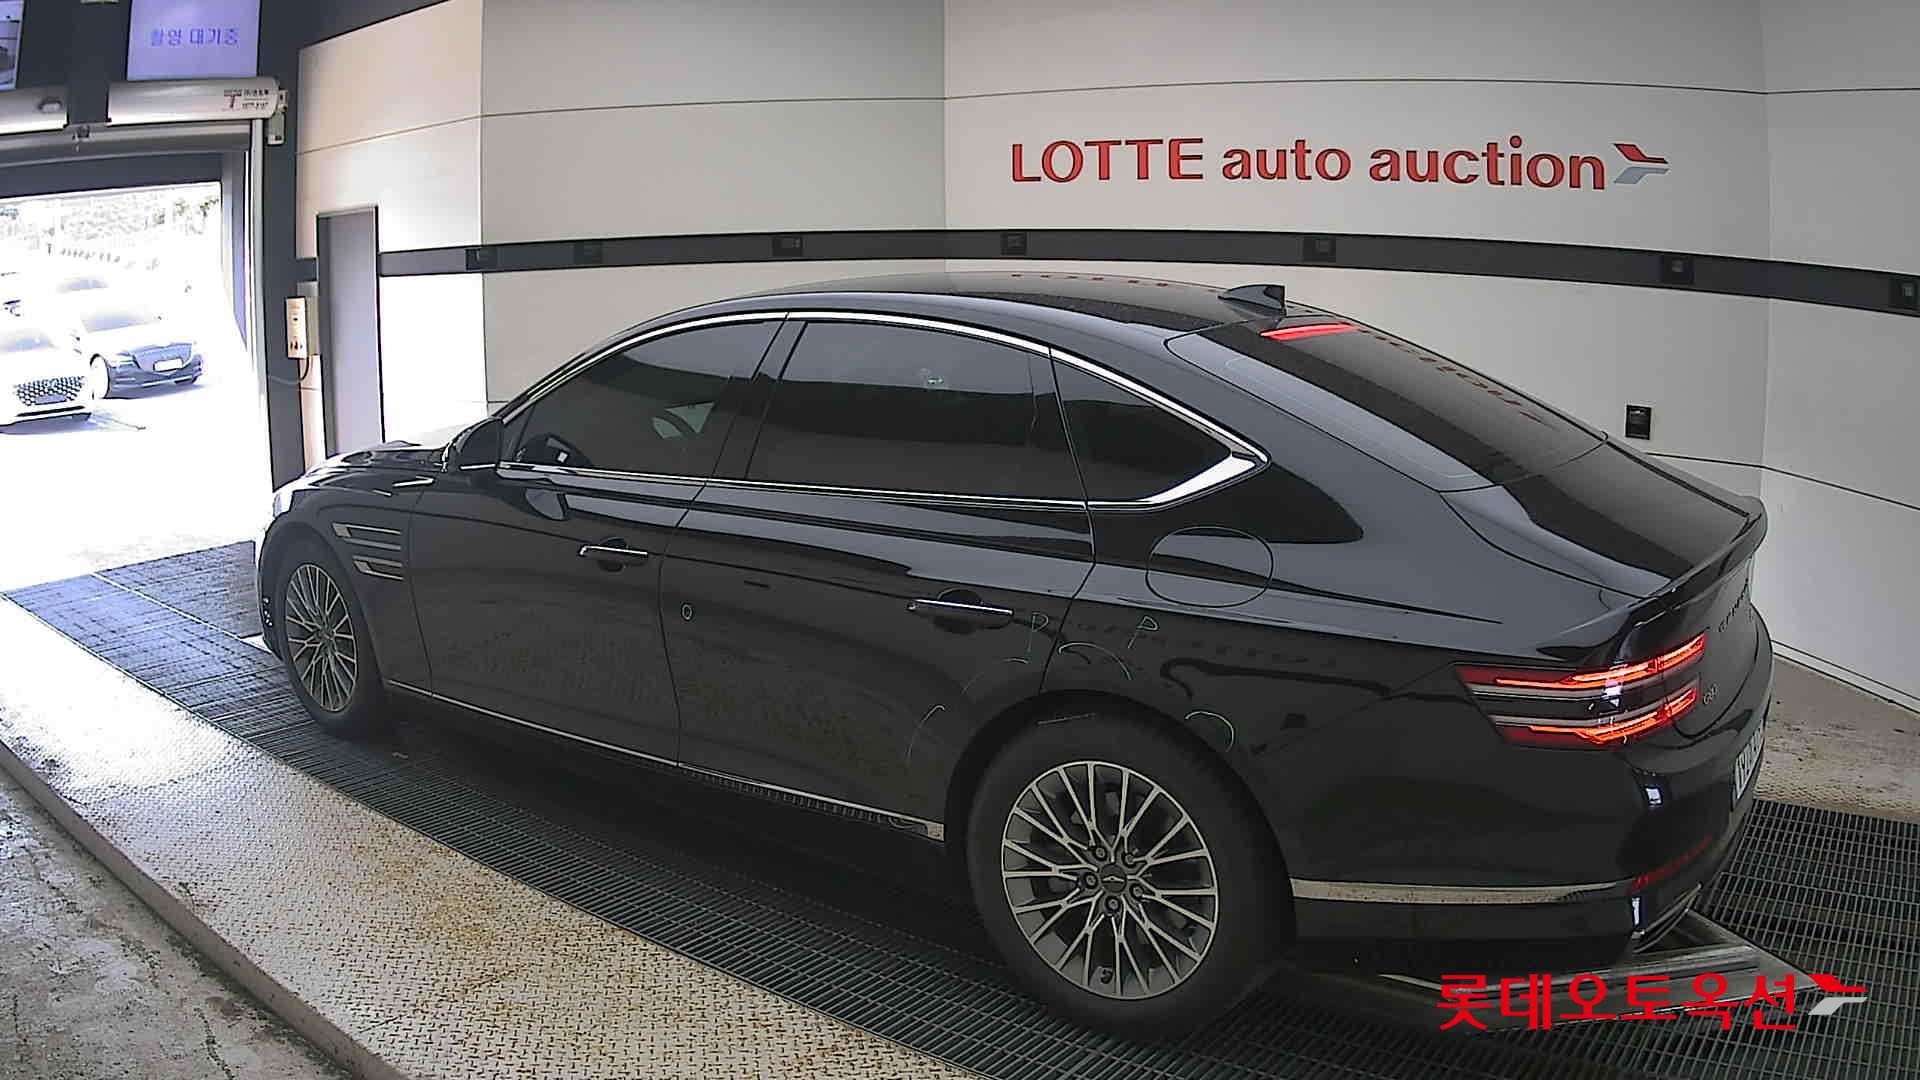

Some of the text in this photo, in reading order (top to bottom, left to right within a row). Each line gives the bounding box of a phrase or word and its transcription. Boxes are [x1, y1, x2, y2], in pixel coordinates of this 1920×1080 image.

[190, 26, 239, 46] 대기중
[1012, 135, 1606, 189] LOTTE auto auction
